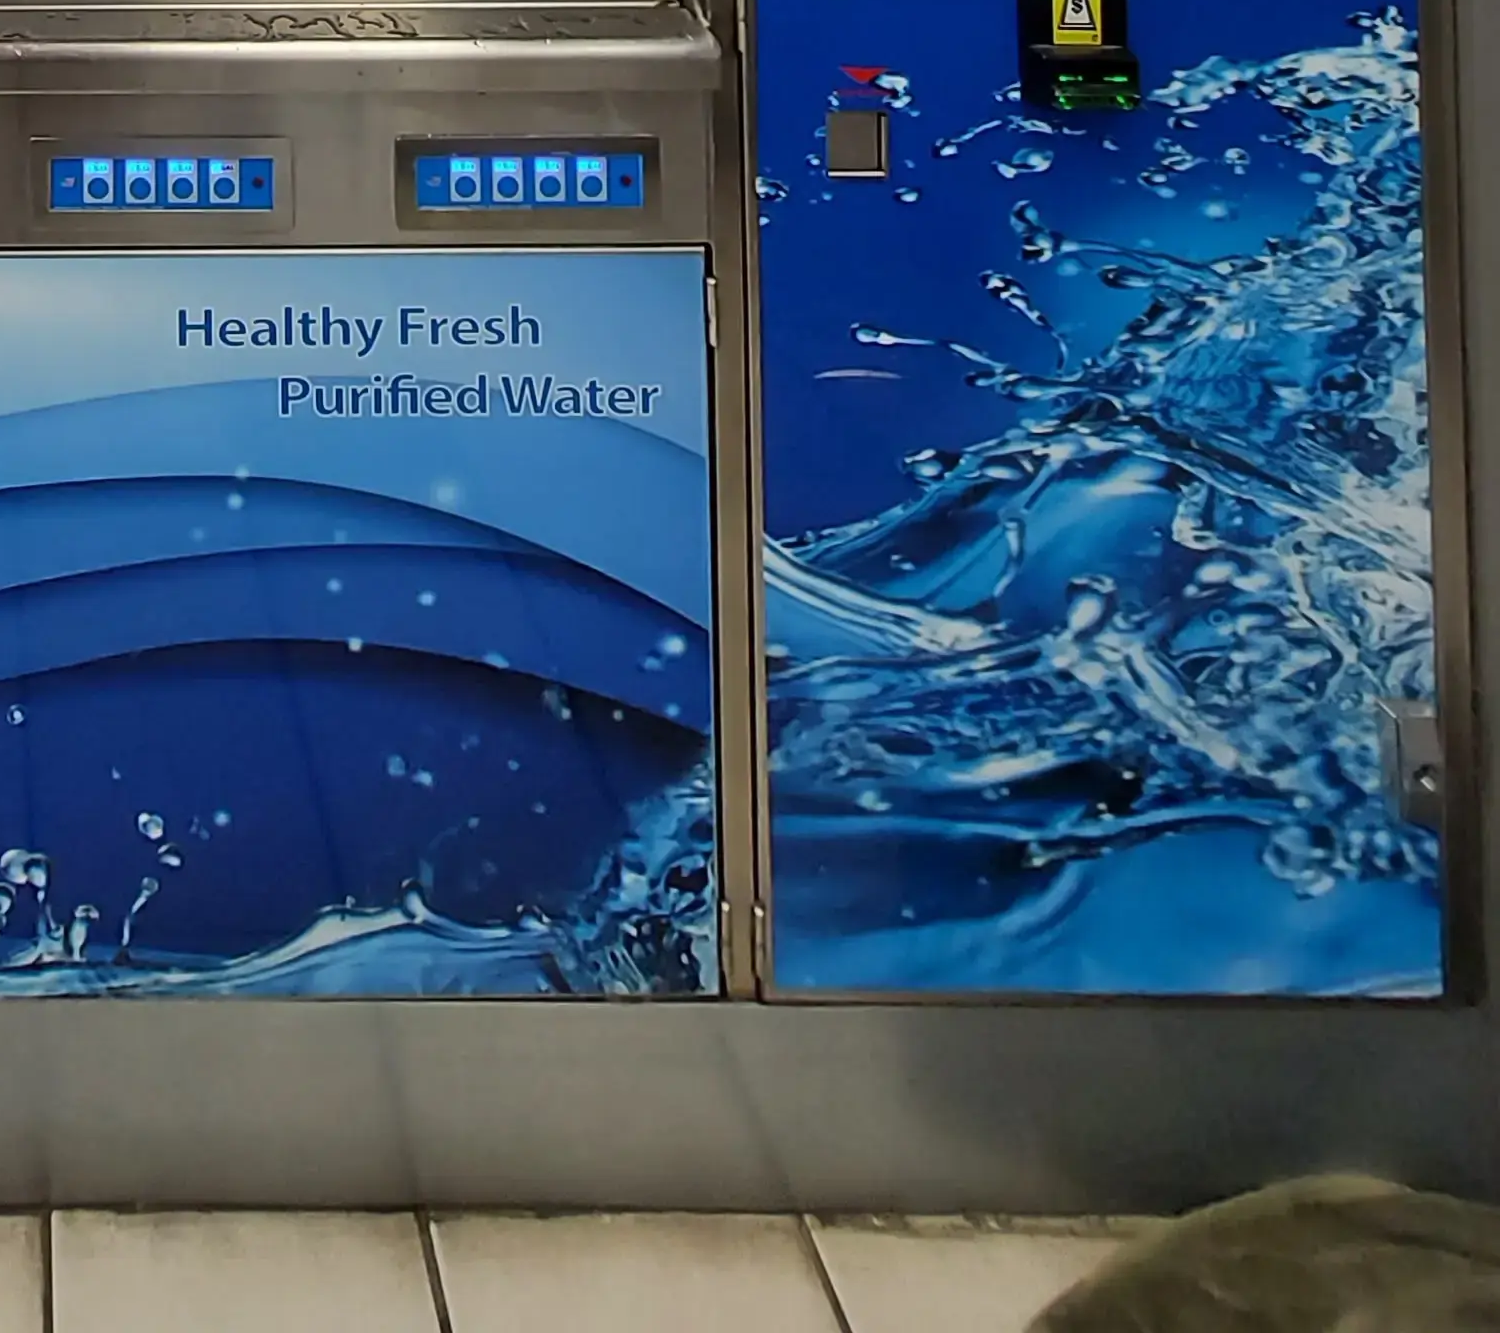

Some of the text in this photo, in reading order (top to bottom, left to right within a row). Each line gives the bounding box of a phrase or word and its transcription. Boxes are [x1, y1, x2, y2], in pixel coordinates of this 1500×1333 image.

[176, 304, 542, 359] Healthy Fresh
[278, 373, 661, 417] Purified Water
